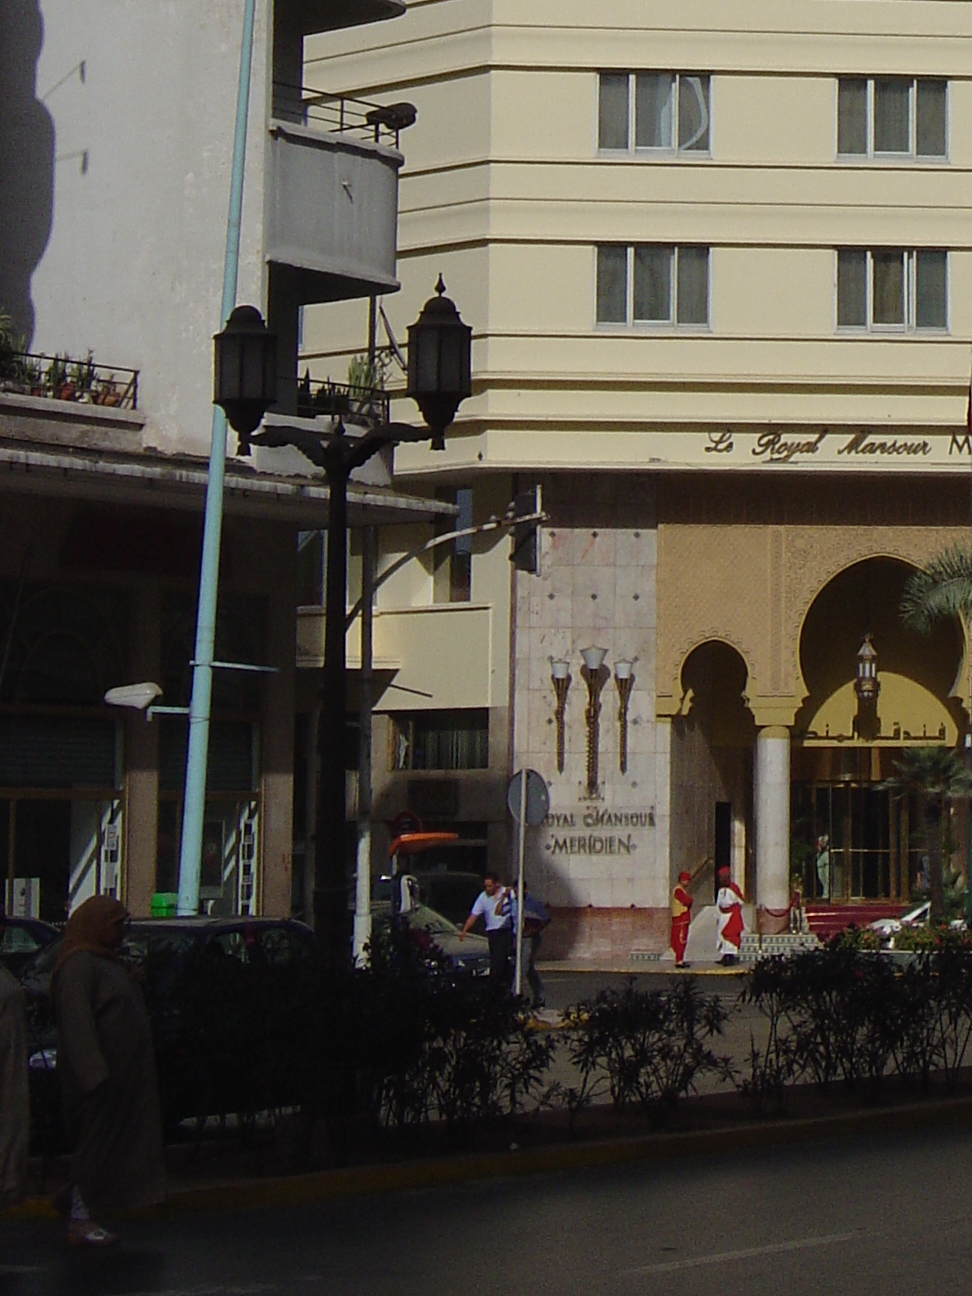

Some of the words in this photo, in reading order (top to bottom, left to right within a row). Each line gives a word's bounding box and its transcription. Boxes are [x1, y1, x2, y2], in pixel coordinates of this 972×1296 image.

[704, 429, 734, 453] Le
[751, 428, 828, 461] Royal
[837, 429, 932, 455] Mansour
[551, 834, 631, 855] MERIDIEN
